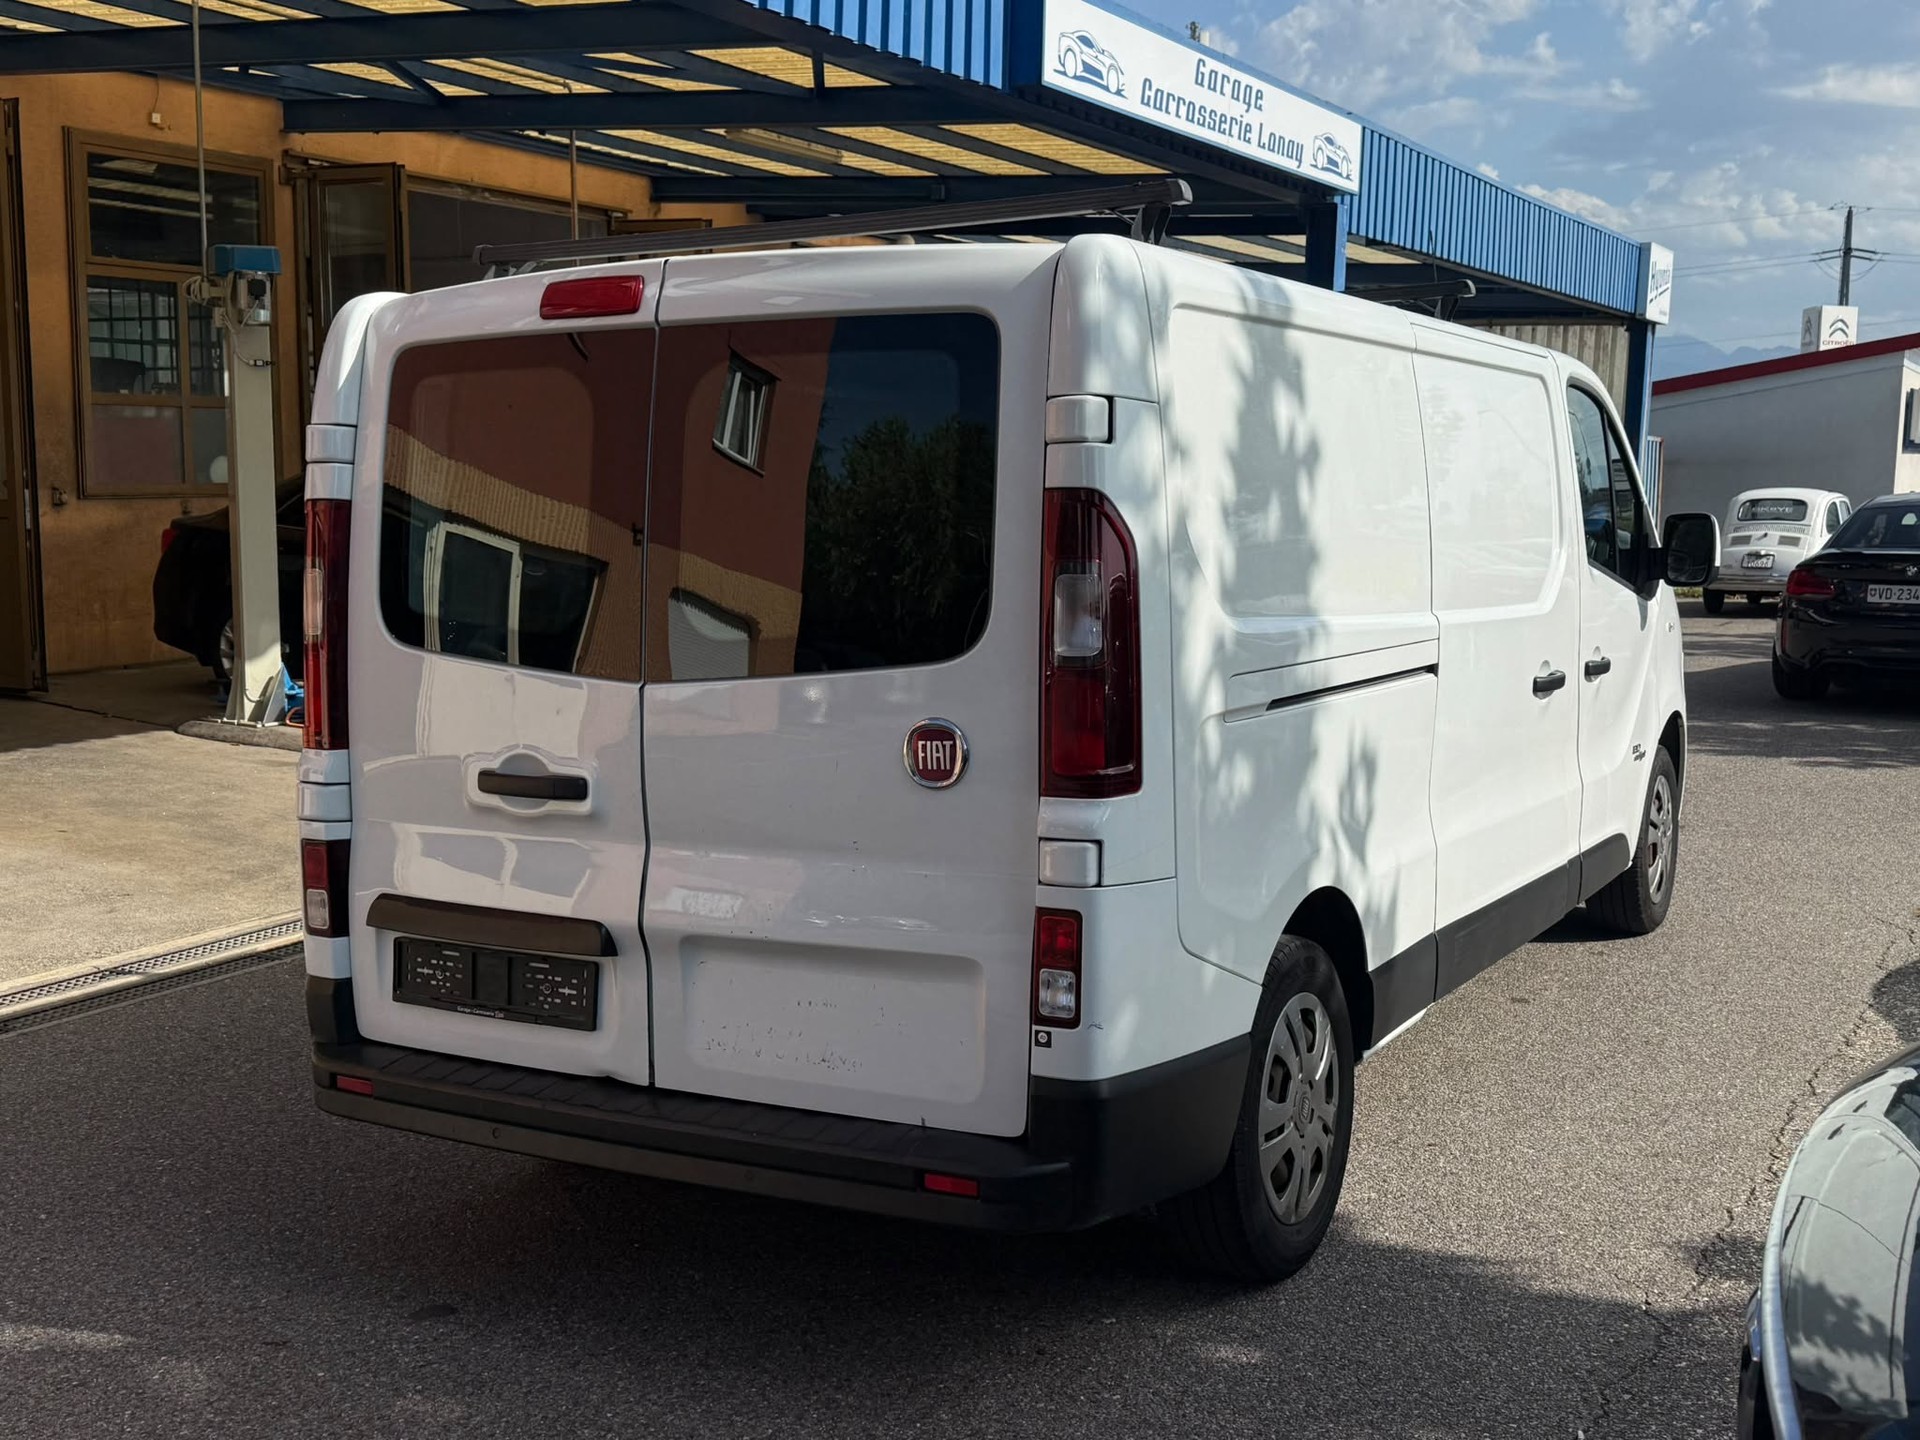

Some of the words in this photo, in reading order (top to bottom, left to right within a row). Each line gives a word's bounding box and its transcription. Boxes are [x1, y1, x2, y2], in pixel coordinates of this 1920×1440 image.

[1195, 58, 1263, 113] Garage
[1140, 77, 1252, 144] Carrosserie
[1258, 122, 1304, 169] Lonay
[918, 741, 953, 770] FIAT
